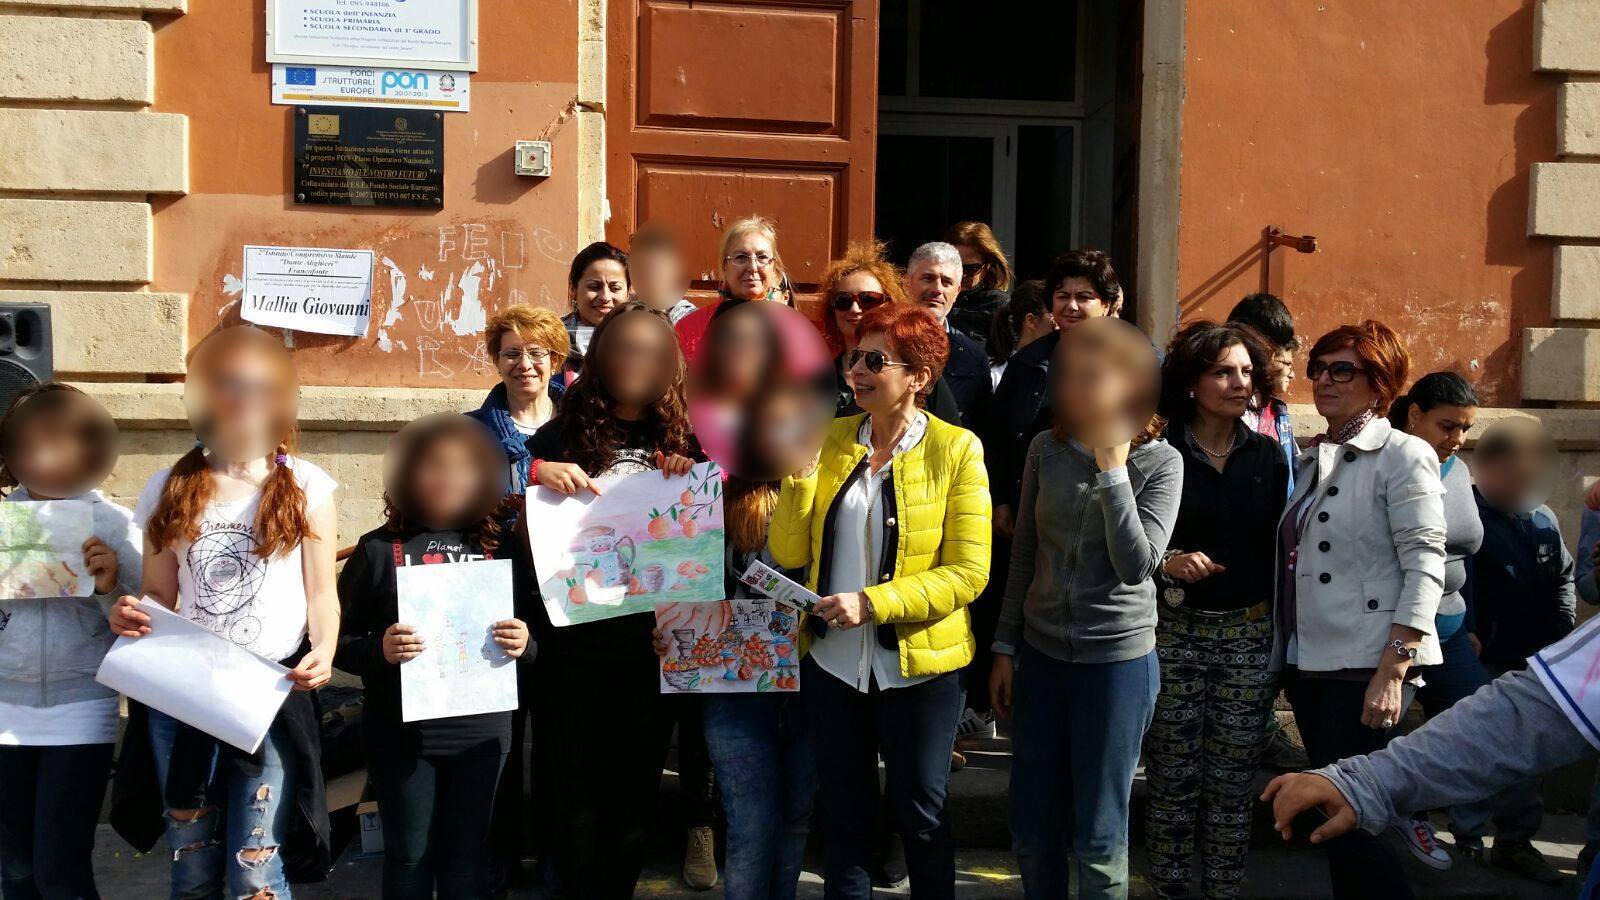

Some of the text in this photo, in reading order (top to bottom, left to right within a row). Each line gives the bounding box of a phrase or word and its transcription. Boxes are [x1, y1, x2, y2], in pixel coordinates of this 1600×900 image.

[350, 69, 375, 77] FONDI
[322, 77, 375, 86] STRUTTURALI
[381, 71, 429, 96] pon
[340, 87, 375, 95] EUROPEI
[290, 249, 333, 259] Comprensivo
[288, 267, 329, 275] Francofonte
[252, 294, 370, 316] Mallia Giovanni
[426, 540, 463, 552] Planet
